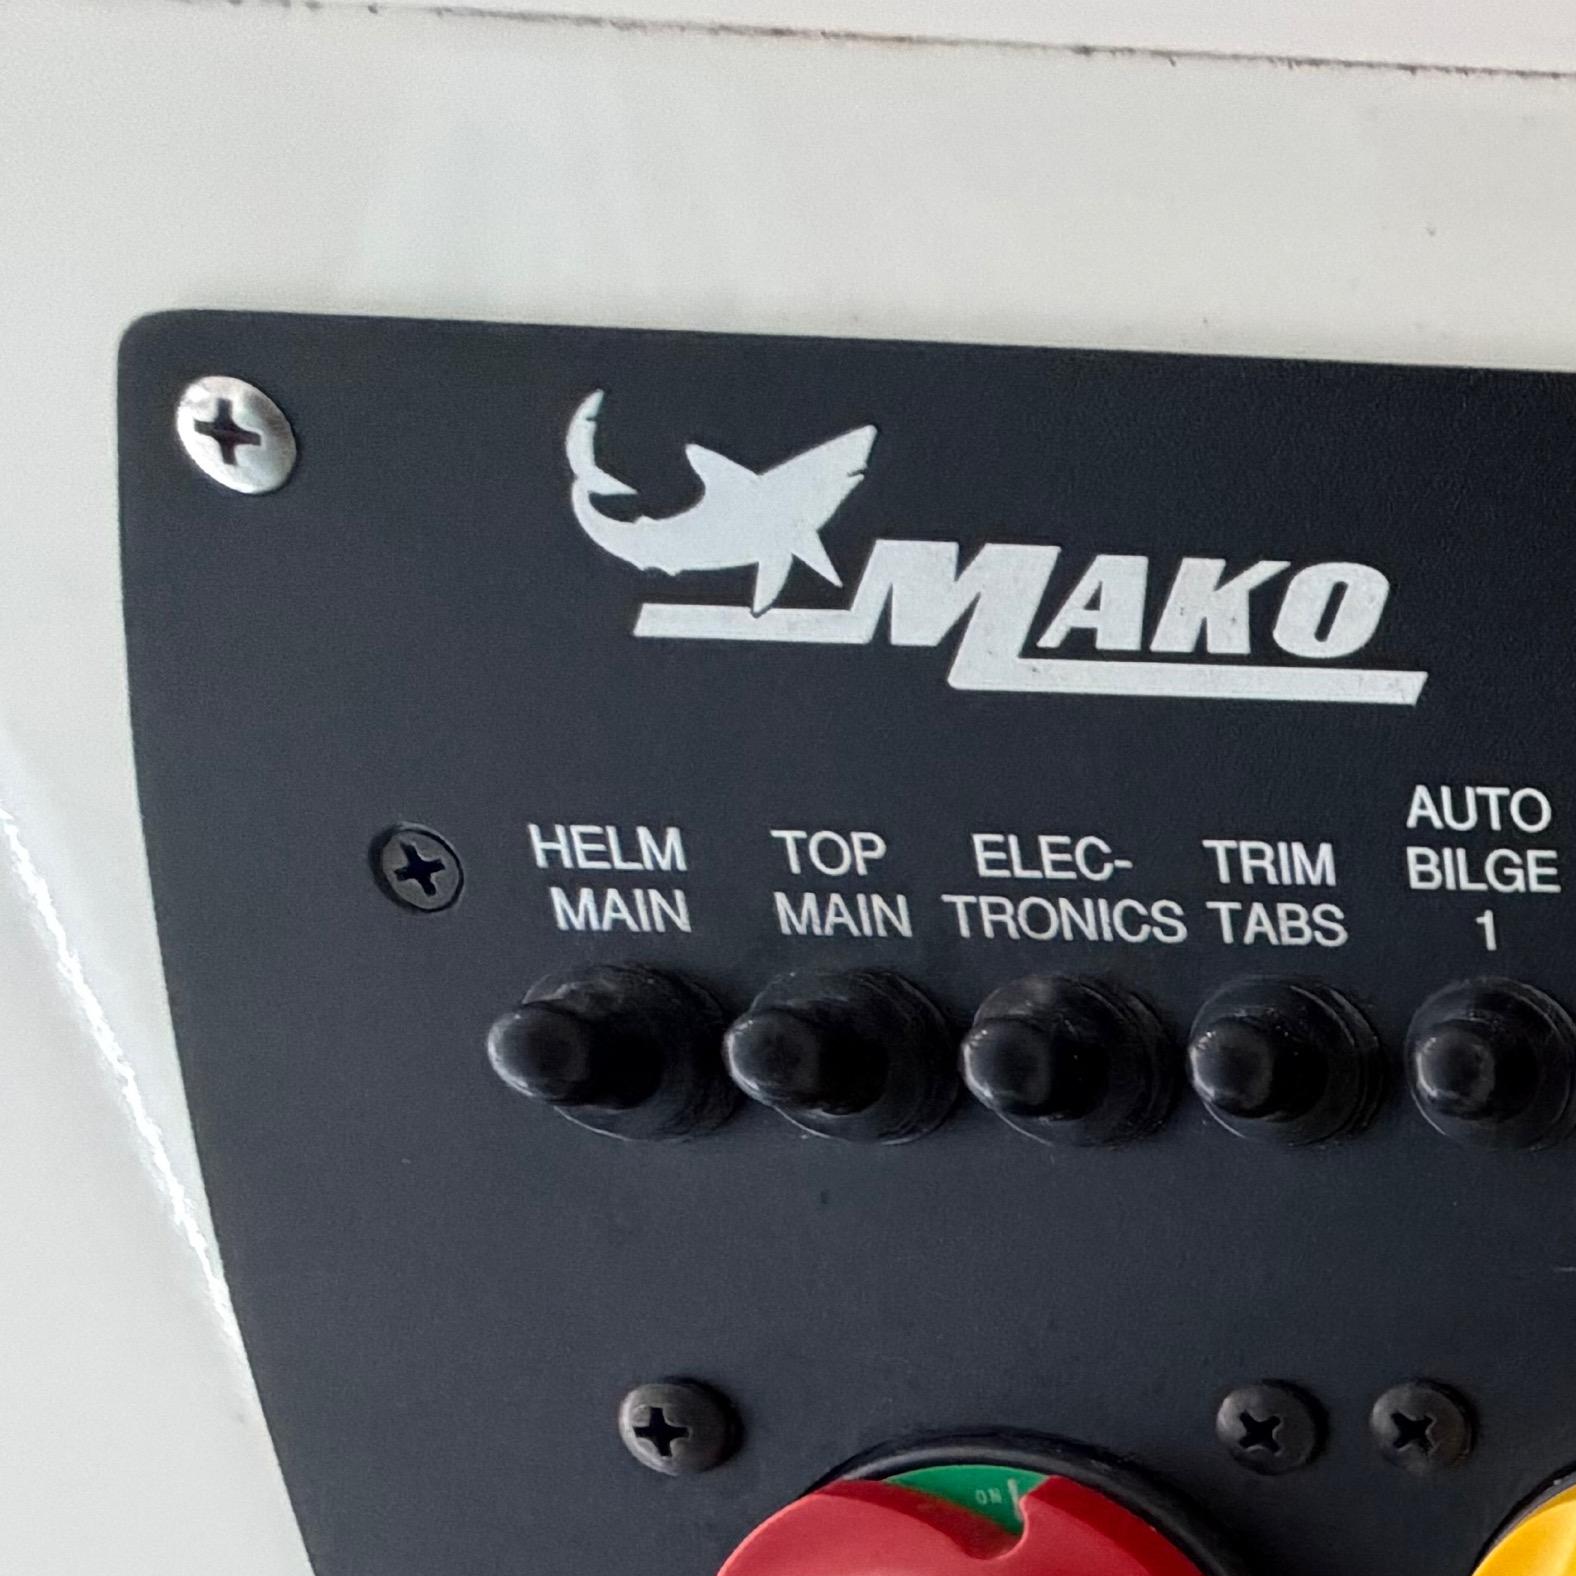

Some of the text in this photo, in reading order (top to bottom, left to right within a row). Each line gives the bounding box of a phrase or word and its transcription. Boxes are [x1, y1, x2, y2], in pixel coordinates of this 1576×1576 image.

[850, 538, 1392, 692] MAKO
[1406, 785, 1552, 834] AUTO
[528, 822, 688, 873] HELM
[771, 828, 888, 876] TOP
[973, 833, 1133, 881] ELEC-
[1203, 839, 1337, 887] TRIM
[1406, 846, 1562, 893] BILGE
[550, 887, 692, 934] MAIN
[777, 892, 912, 940] MAIN
[942, 894, 1188, 944] TRONICS
[1207, 900, 1348, 948] TABS
[1475, 909, 1497, 951] 1
